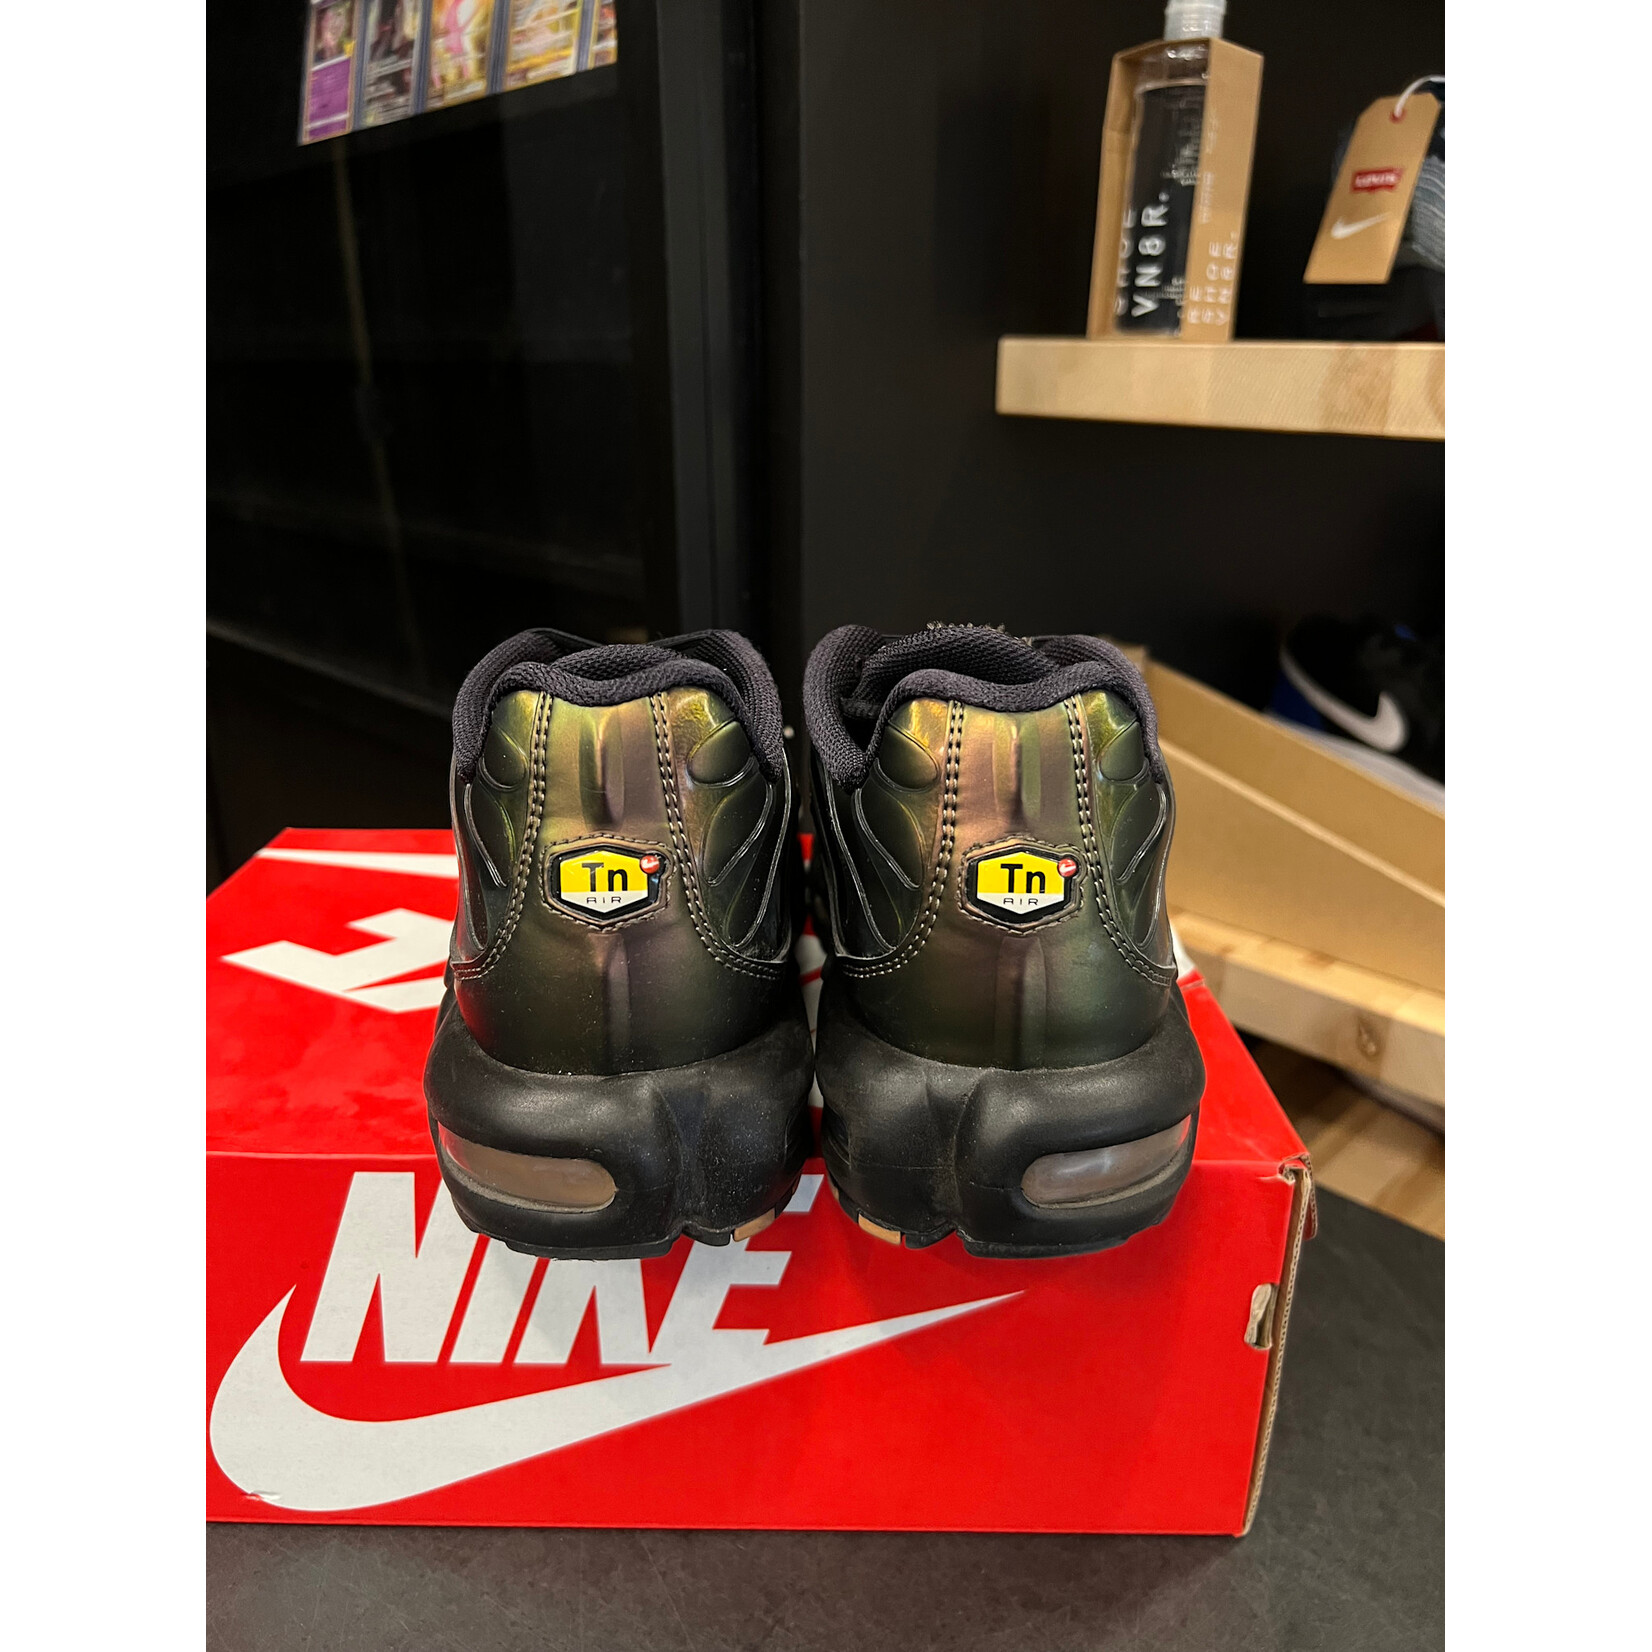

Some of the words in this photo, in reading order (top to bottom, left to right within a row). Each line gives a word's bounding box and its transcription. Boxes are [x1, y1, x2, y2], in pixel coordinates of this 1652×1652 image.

[582, 862, 628, 893] Tn
[1000, 863, 1046, 894] Tn
[586, 896, 622, 904] AIR
[1003, 897, 1039, 905] AIR
